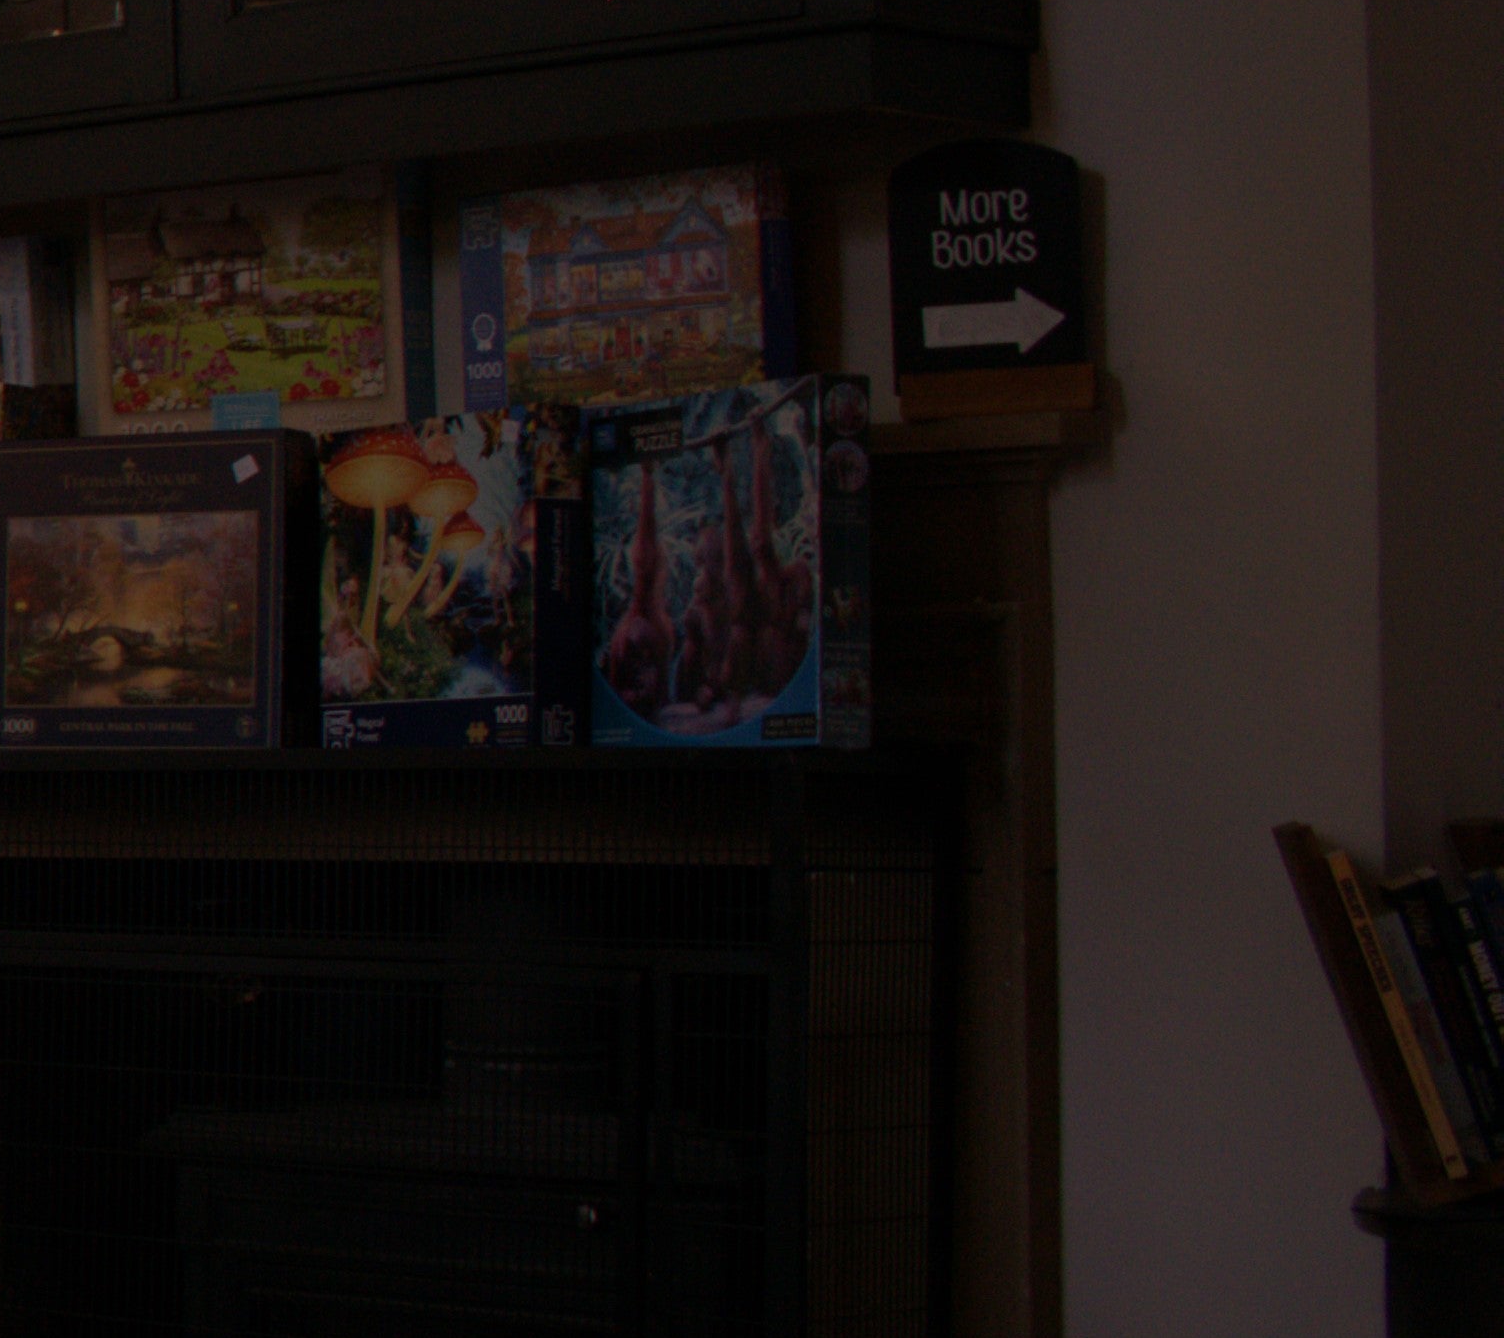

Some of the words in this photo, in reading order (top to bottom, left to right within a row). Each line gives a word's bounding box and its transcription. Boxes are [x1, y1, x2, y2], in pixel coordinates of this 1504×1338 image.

[937, 184, 1030, 225] More
[930, 227, 1037, 271] Books
[465, 361, 504, 380] 1000
[494, 704, 529, 724] 1000
